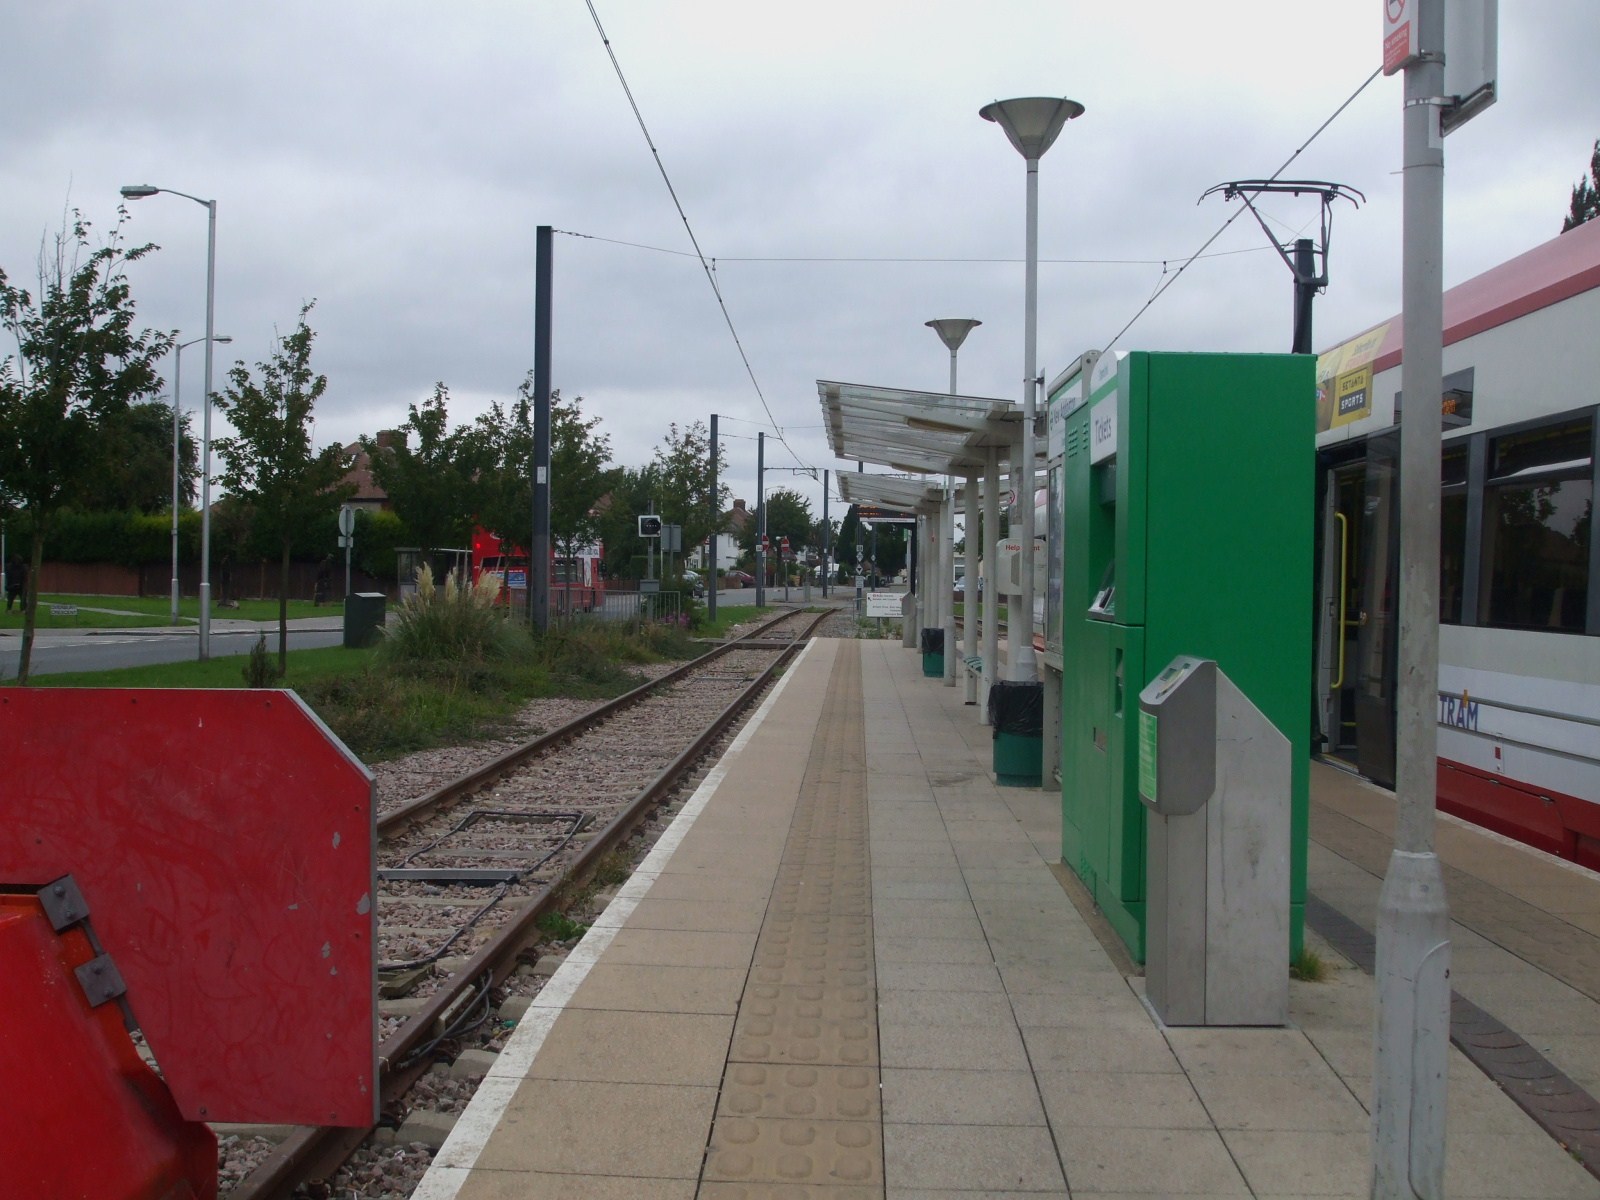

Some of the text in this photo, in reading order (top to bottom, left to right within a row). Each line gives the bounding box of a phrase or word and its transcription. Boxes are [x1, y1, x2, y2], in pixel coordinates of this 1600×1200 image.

[1342, 376, 1364, 391] SETANTA
[1341, 393, 1364, 410] SPORTS
[1095, 415, 1112, 446] Tickets
[1005, 544, 1021, 552] Help
[1439, 695, 1479, 732] TRAM
